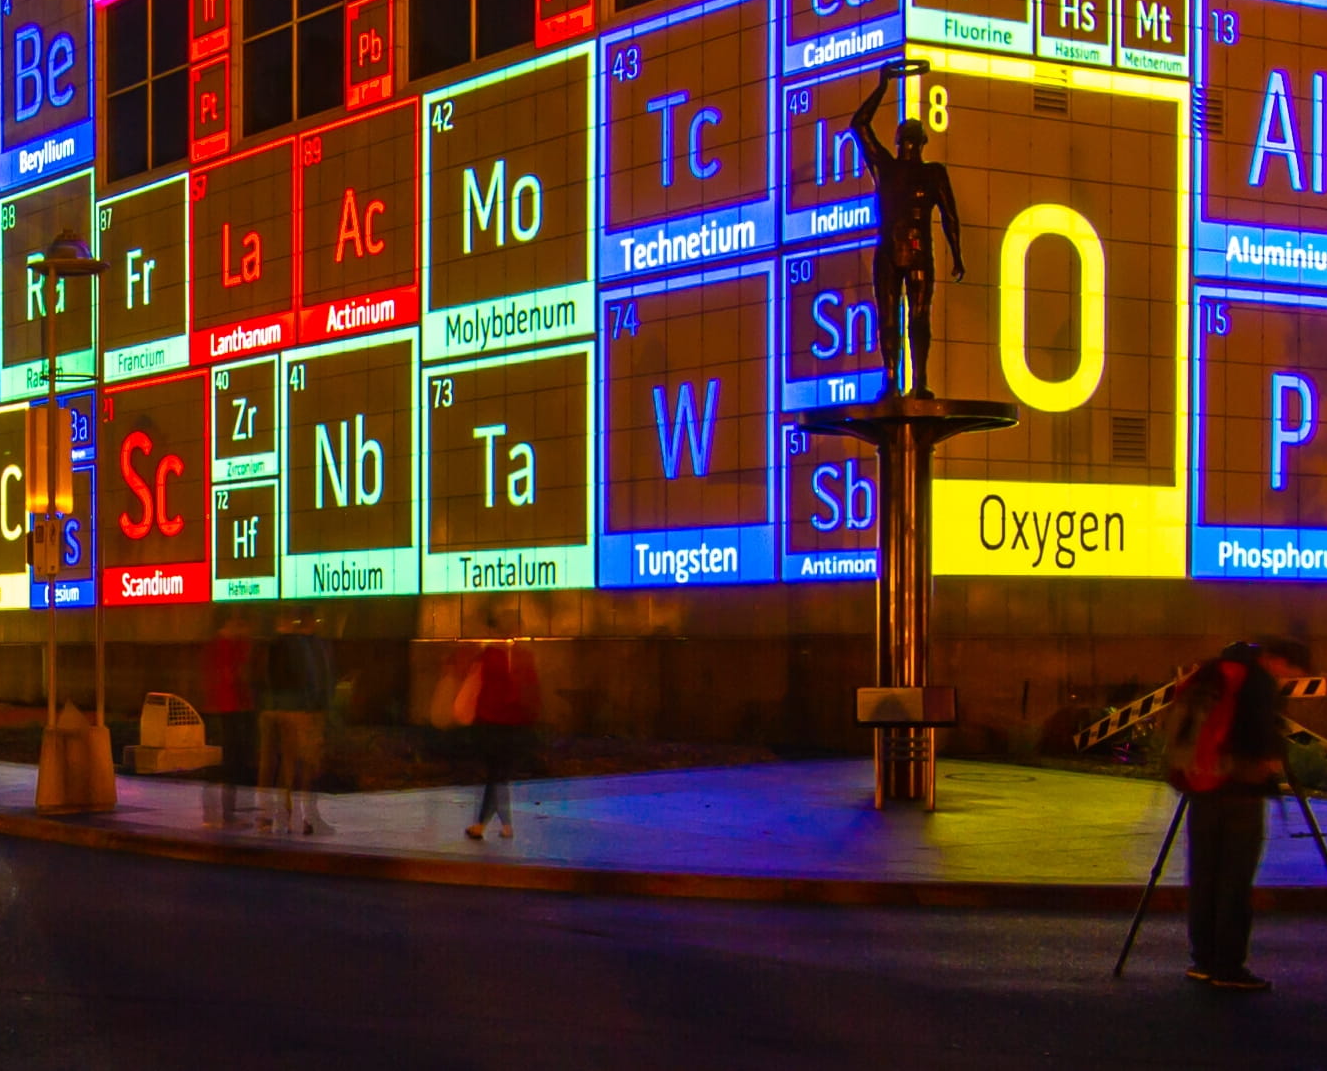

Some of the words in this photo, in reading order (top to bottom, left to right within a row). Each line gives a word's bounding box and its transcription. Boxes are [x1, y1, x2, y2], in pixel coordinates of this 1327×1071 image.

[944, 17, 1013, 45] Fluorine
[1136, 0, 1172, 43] Mt
[1212, 11, 1235, 44] 13
[612, 48, 639, 82] 43
[804, 29, 884, 68] Cadmium
[1055, 43, 1099, 61] Hassium
[1125, 53, 1182, 72] Meitnerium
[16, 27, 73, 121] Be
[432, 101, 453, 133] 42
[789, 90, 810, 115] 49
[928, 85, 949, 133] 8
[648, 90, 721, 187] Tc
[1248, 71, 1323, 193] Al
[19, 138, 74, 173] Beryllium
[816, 121, 862, 185] In
[2, 206, 16, 229] 88
[336, 189, 385, 262] Ac
[463, 160, 542, 254] Mo
[811, 206, 870, 235] Indium
[222, 224, 261, 287] La
[620, 217, 755, 273] Technetium
[126, 249, 155, 309] Fr
[789, 259, 811, 284] 50
[327, 294, 395, 330] Actinium
[445, 296, 576, 352] Molybdenum
[610, 304, 639, 341] 74
[812, 291, 878, 361] Sn
[1000, 204, 1106, 413] O
[1204, 304, 1227, 335] 15
[210, 321, 281, 356] Lanthanum
[118, 346, 164, 370] Francium
[216, 368, 229, 391] 40
[289, 367, 305, 391] 41
[432, 379, 453, 409] 73
[828, 379, 855, 403] Tin
[232, 399, 257, 441] Zr
[653, 378, 719, 480] W
[1272, 372, 1312, 490] P
[227, 459, 265, 477] Zirconium
[316, 414, 384, 507] Nb
[473, 424, 535, 508] Ta
[0, 464, 21, 541] C
[119, 431, 184, 540] Sc
[217, 489, 228, 510] 72
[811, 460, 877, 530] Sb
[233, 517, 258, 559] Hf
[980, 495, 1125, 569] Oxygen
[314, 561, 383, 592] Niobium
[460, 556, 557, 588] Tantalum
[635, 545, 737, 583] Tungsten
[121, 574, 183, 598] Scandium
[228, 580, 260, 596] Hafnium
